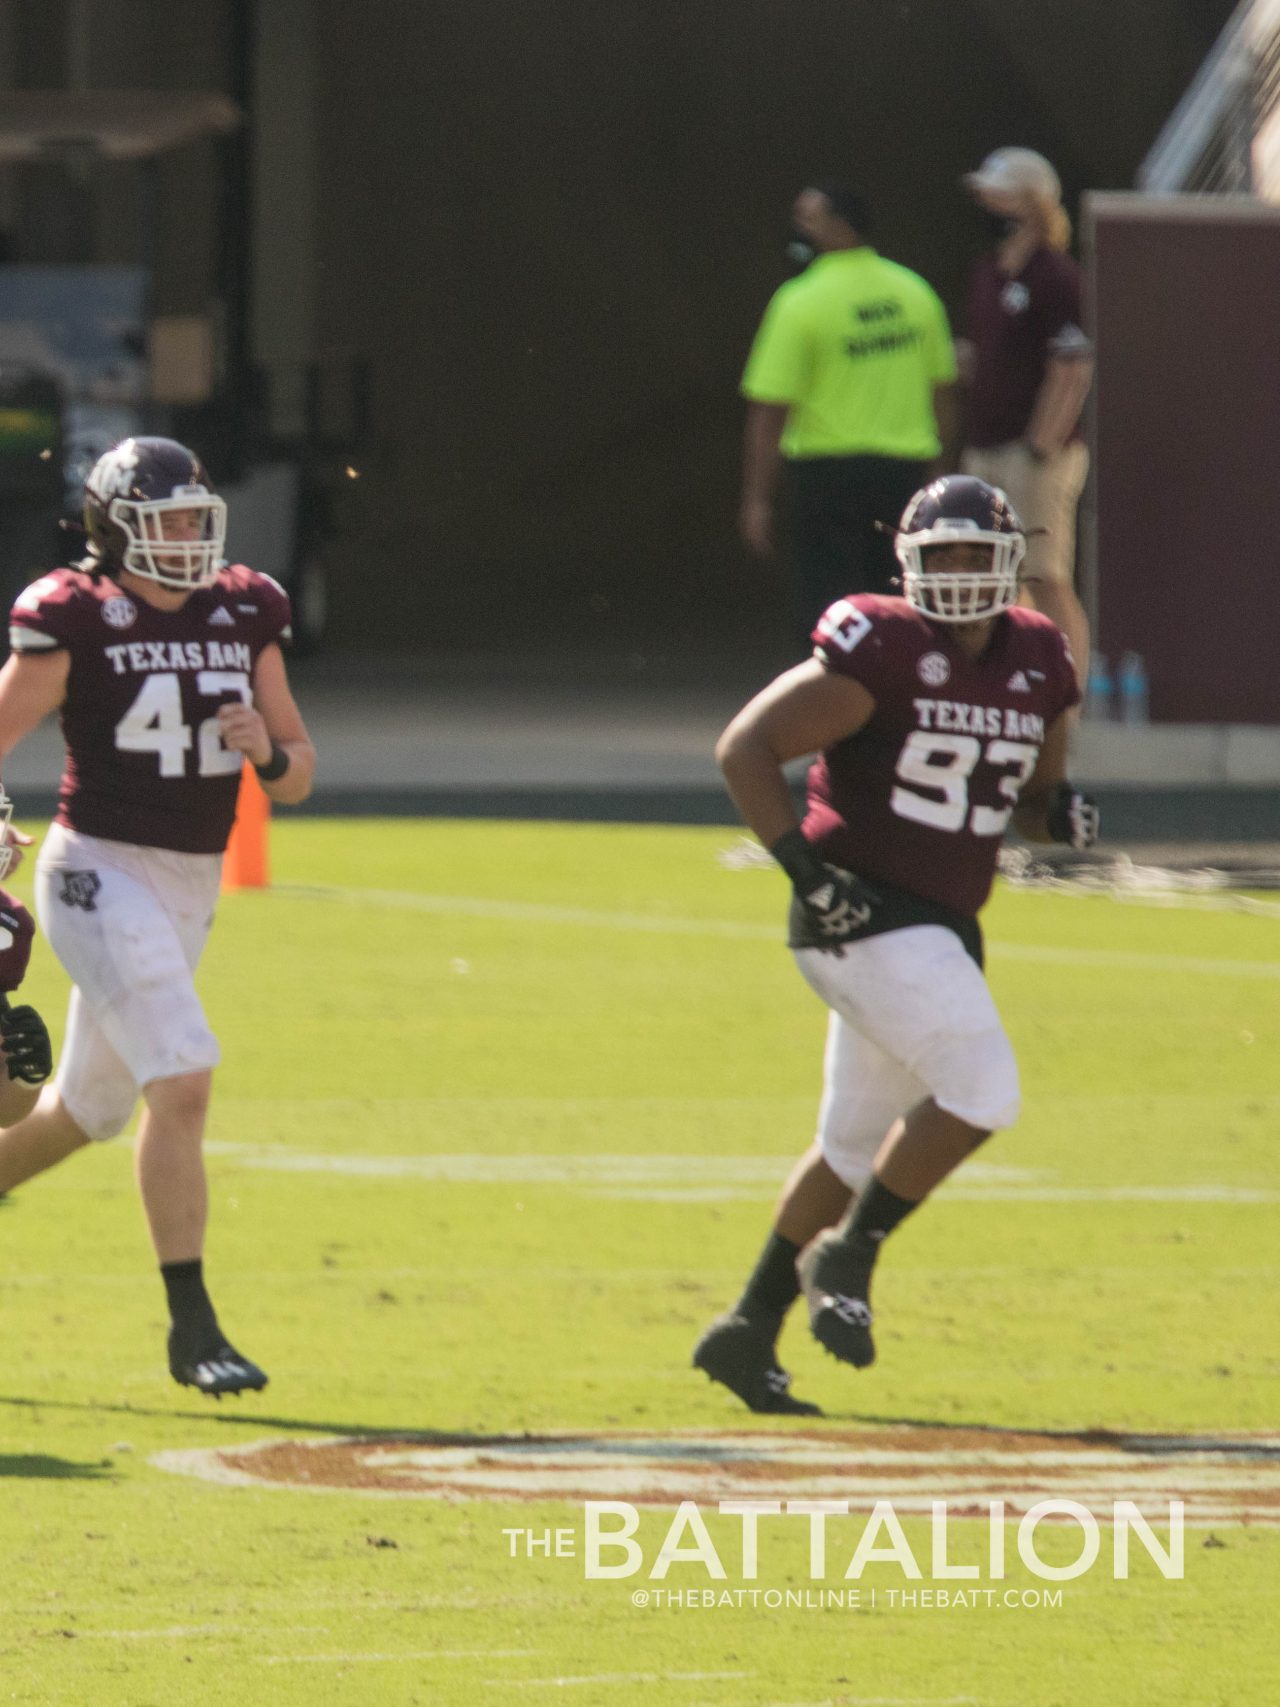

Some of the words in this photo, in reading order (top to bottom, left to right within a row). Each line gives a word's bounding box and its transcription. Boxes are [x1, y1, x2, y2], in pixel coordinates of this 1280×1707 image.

[104, 641, 205, 674] TEXAS
[206, 640, 252, 672] A&M
[114, 671, 253, 779] 42
[913, 698, 1002, 737] TEXAS
[1004, 708, 1046, 744] A&M
[889, 730, 1041, 837] 93
